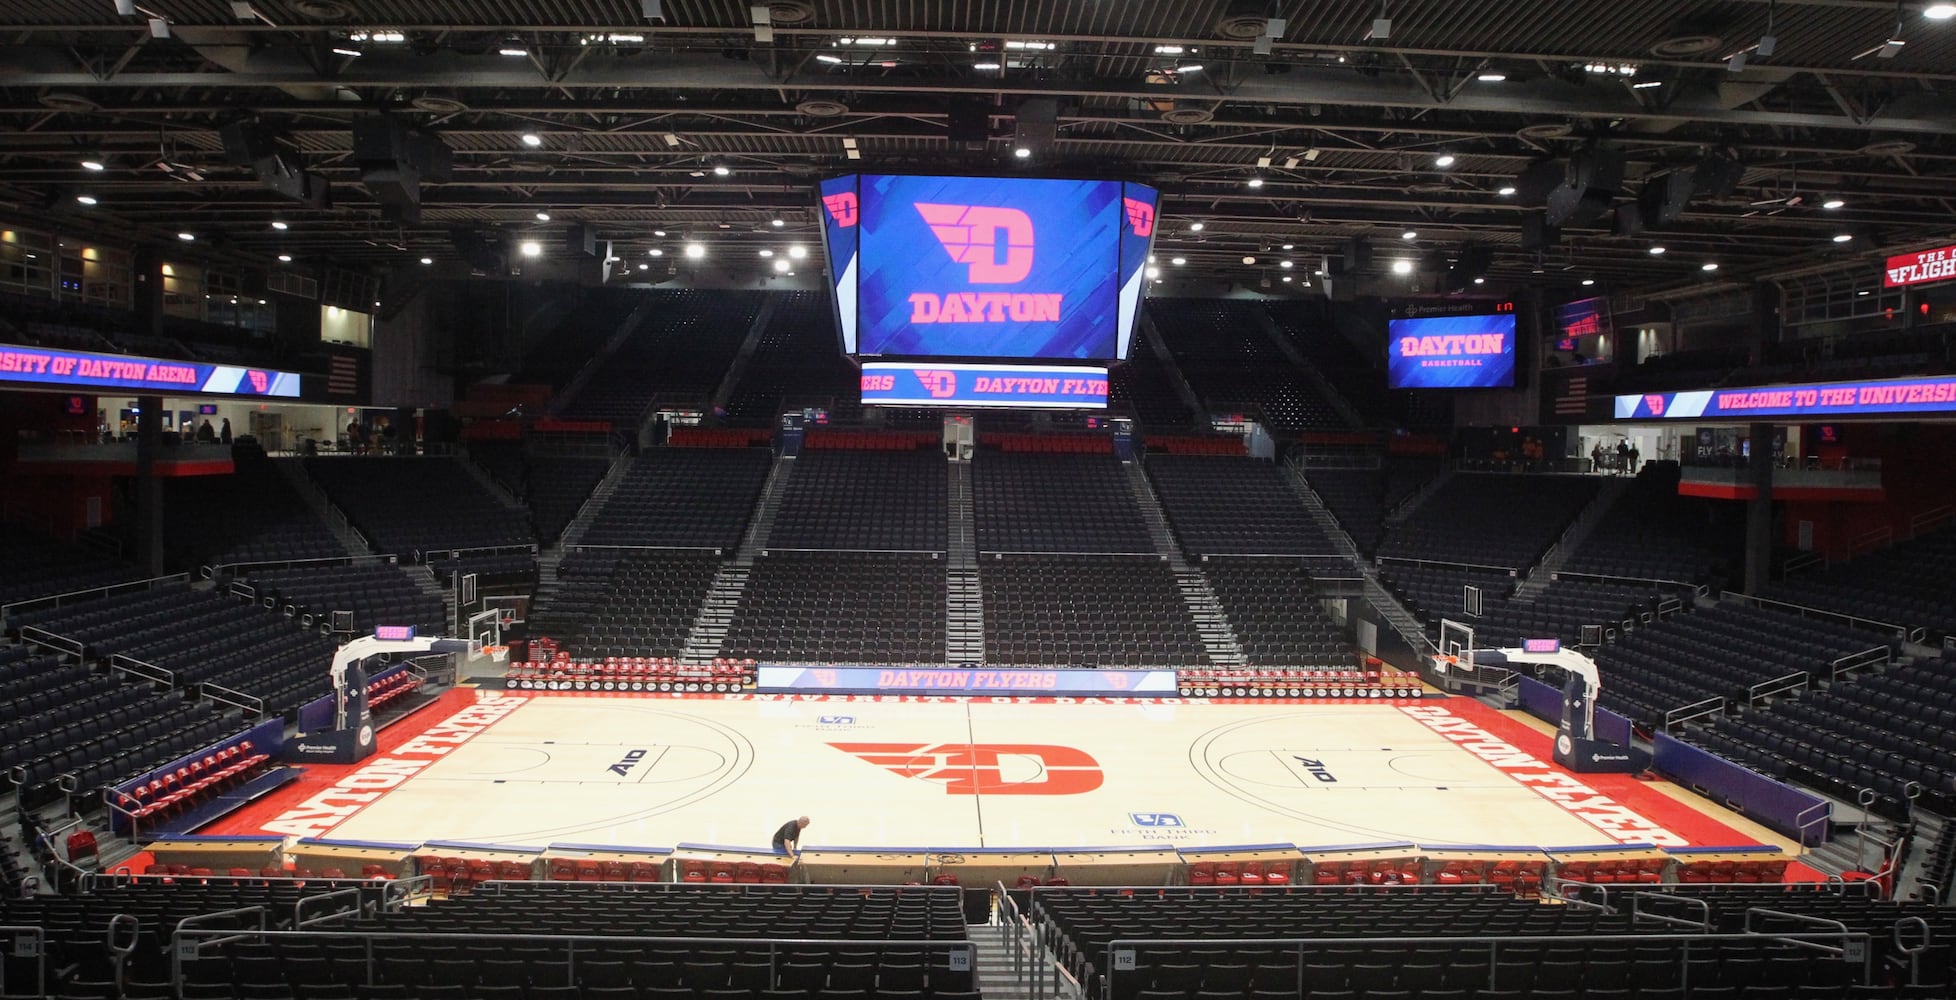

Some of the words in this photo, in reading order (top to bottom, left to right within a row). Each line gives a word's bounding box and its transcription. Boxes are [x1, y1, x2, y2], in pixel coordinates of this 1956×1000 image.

[1918, 251, 1945, 264] THE
[908, 293, 1062, 323] DAYTON
[1418, 305, 1447, 313] Premier
[1448, 303, 1473, 312] Health
[1400, 333, 1505, 356] DAYTON
[0, 352, 51, 374] SITY
[52, 357, 78, 376] OF
[77, 359, 147, 381] DAYTON
[146, 365, 197, 384] ARENA
[1421, 359, 1483, 367] BASKETBALL
[973, 377, 1060, 394] DAYTON
[1719, 391, 1794, 410] WELCOME
[1795, 389, 1818, 407] TO
[1820, 388, 1858, 406] THE
[877, 671, 971, 689] DAYTON
[971, 672, 1057, 689] FLYERS
[390, 695, 529, 755] FLYERS
[1398, 705, 1551, 768] DAYTON
[953, 957, 967, 965] 113
[1118, 956, 1132, 964] 112
